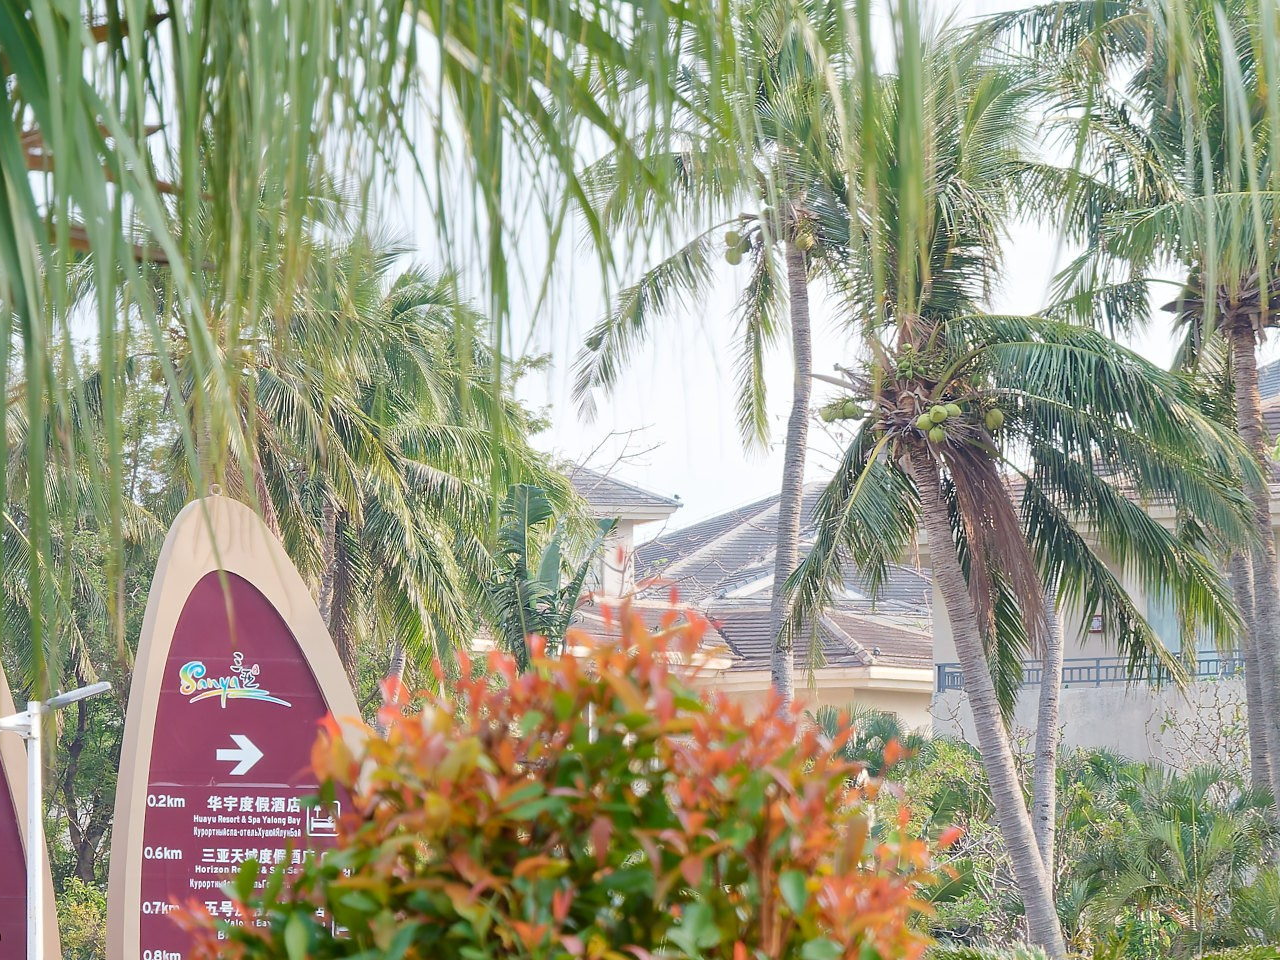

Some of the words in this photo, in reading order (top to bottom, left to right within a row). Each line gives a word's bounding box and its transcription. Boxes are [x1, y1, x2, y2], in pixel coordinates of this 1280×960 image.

[179, 661, 240, 708] Sanya
[147, 795, 186, 808] 0.2km
[207, 796, 301, 812] 华宇度假酒店
[193, 814, 216, 824] Huayu
[217, 815, 240, 824] Resort
[248, 816, 260, 825] Spa
[262, 816, 286, 826] Yalong
[287, 816, 301, 826] Bay
[144, 847, 183, 860] 0.6km
[195, 865, 230, 874] Horizon
